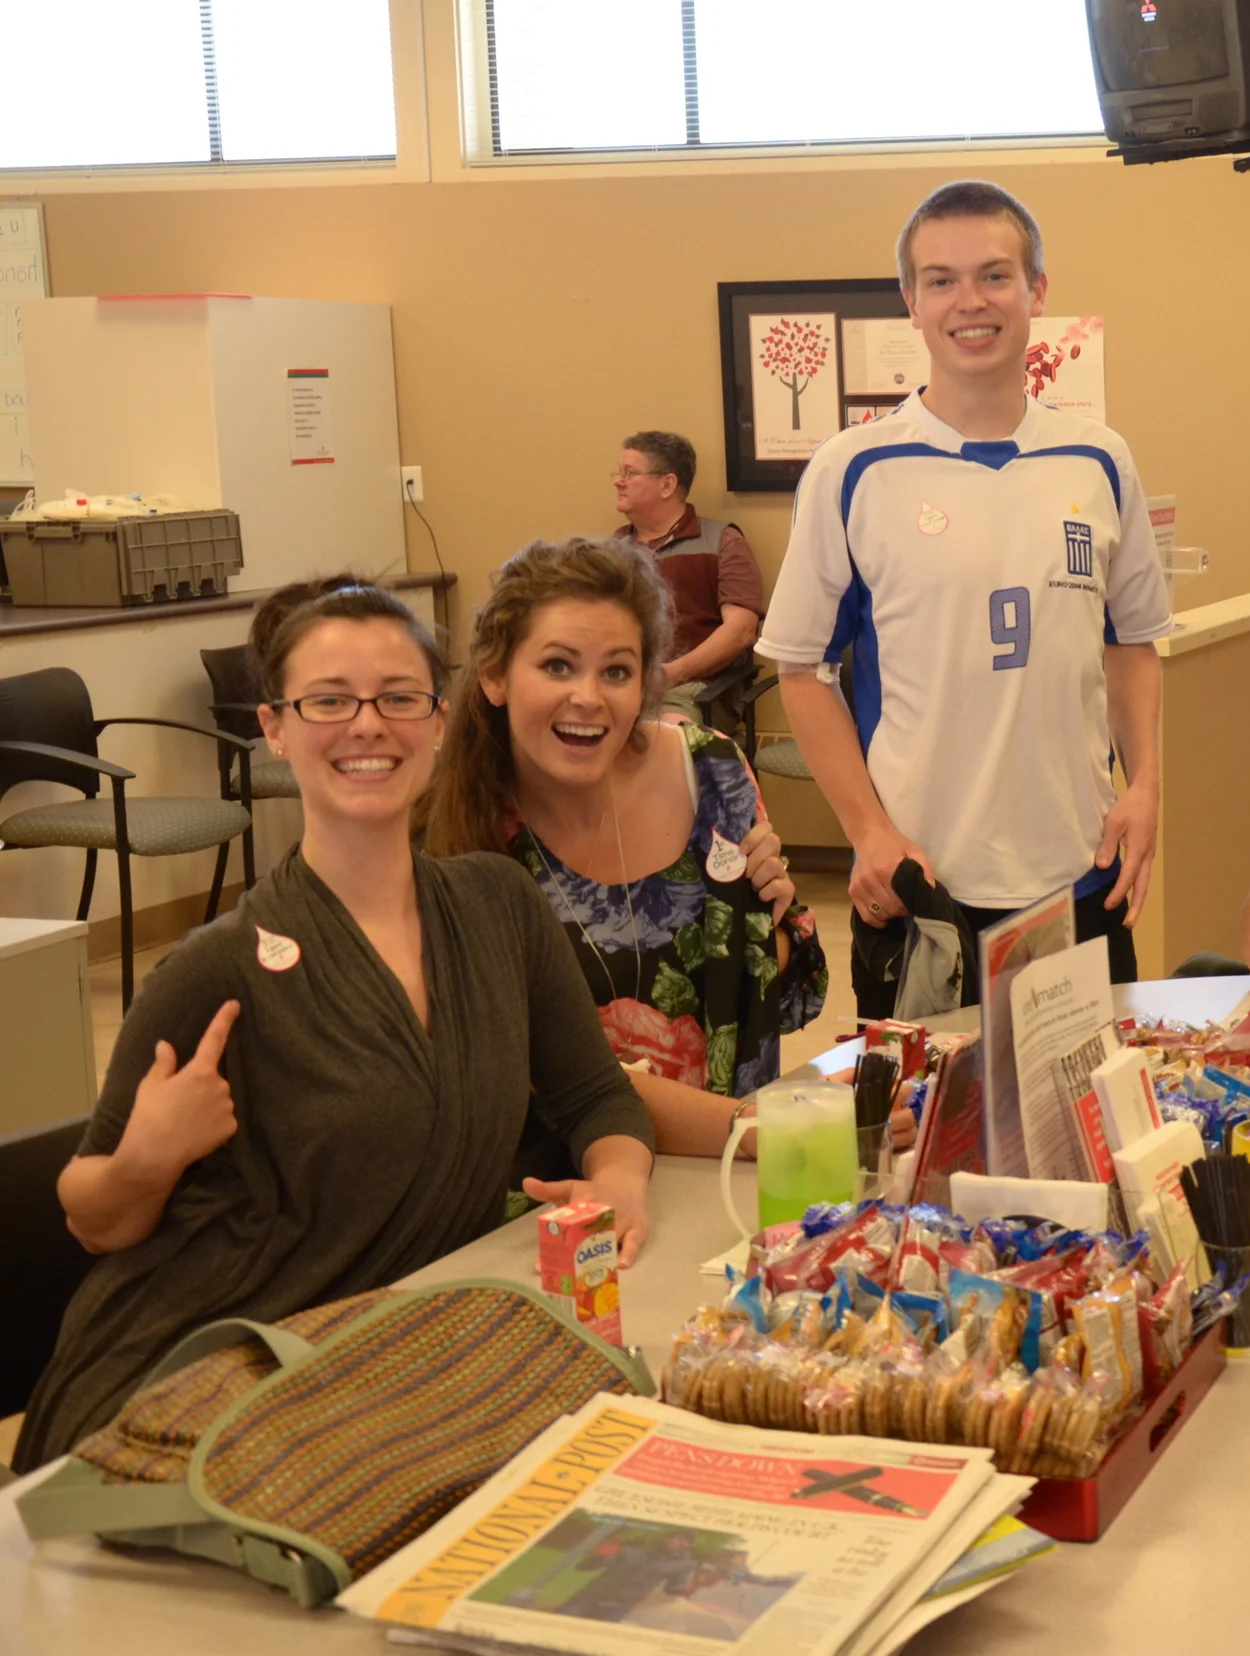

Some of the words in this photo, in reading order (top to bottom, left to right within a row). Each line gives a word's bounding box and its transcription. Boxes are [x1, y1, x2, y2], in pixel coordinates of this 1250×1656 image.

[989, 586, 1031, 671] 9
[576, 1239, 613, 1265] OASIS
[399, 1478, 589, 1601] NATIONAL
[551, 1408, 651, 1474] POST
